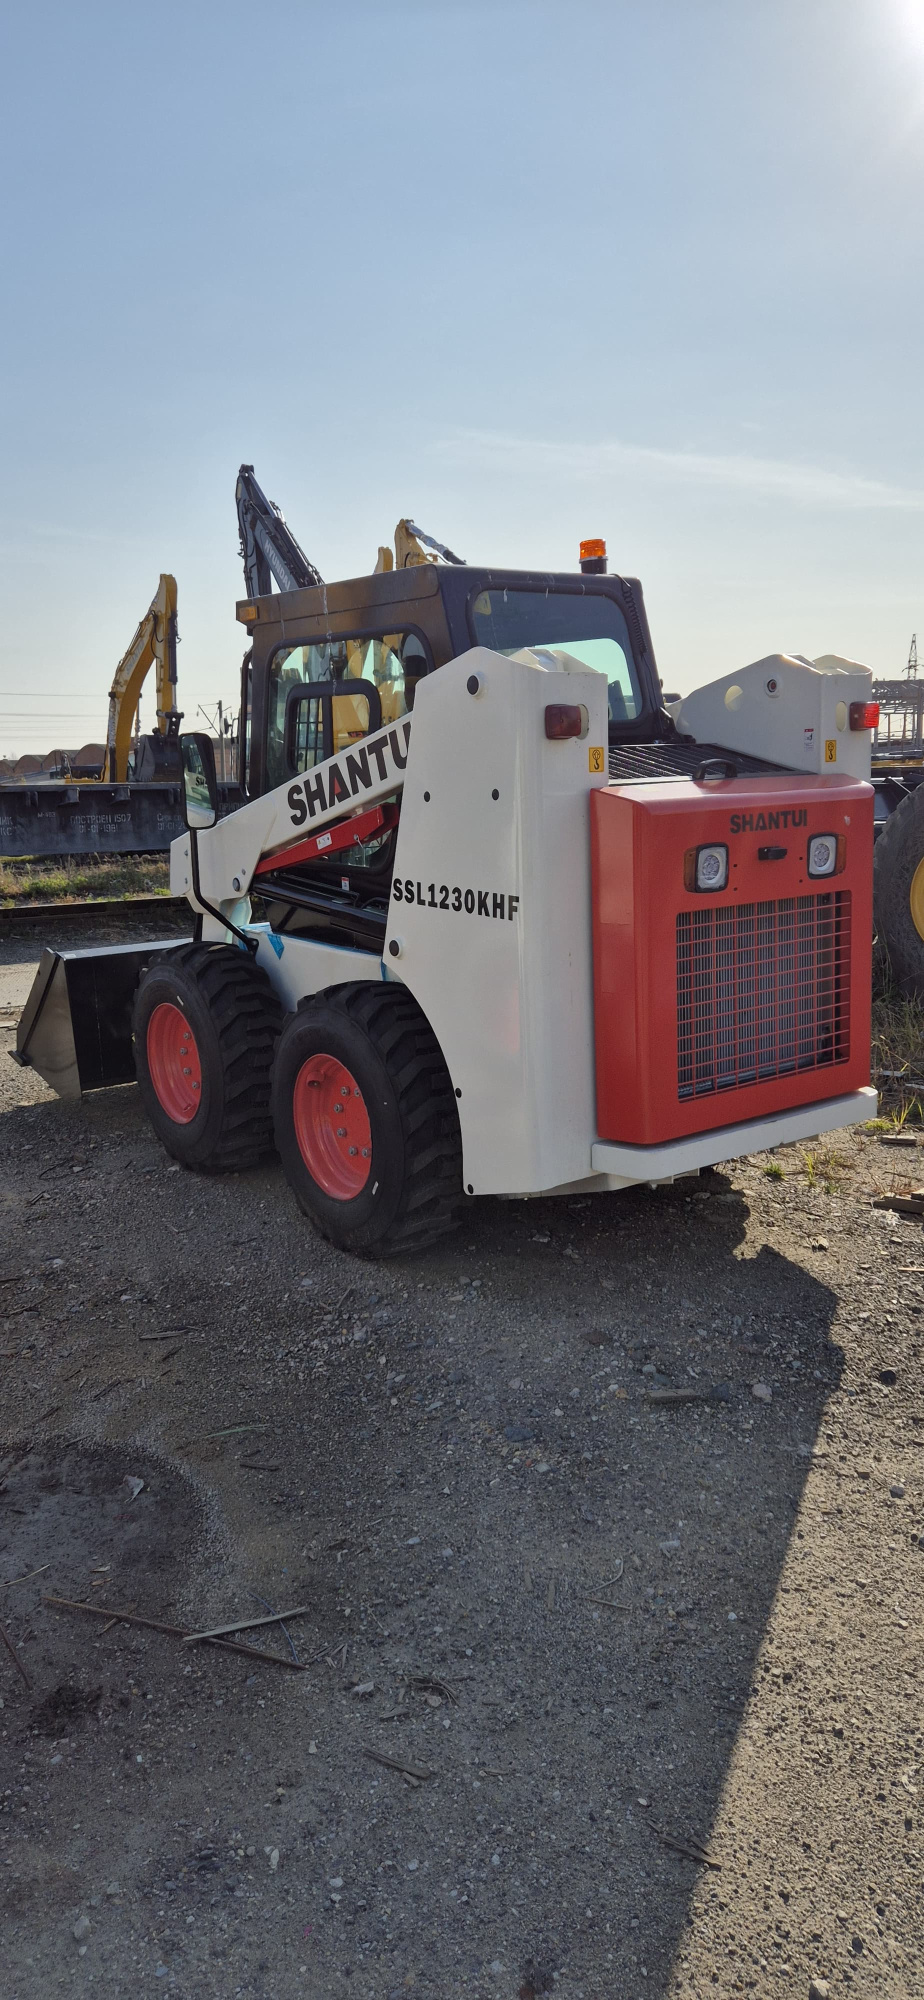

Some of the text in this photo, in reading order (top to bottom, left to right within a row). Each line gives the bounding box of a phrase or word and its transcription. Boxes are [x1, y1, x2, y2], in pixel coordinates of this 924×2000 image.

[264, 540, 291, 591] HYUNDAI
[730, 809, 808, 834] SHANTUI
[392, 877, 520, 921] SSL1230KHF
